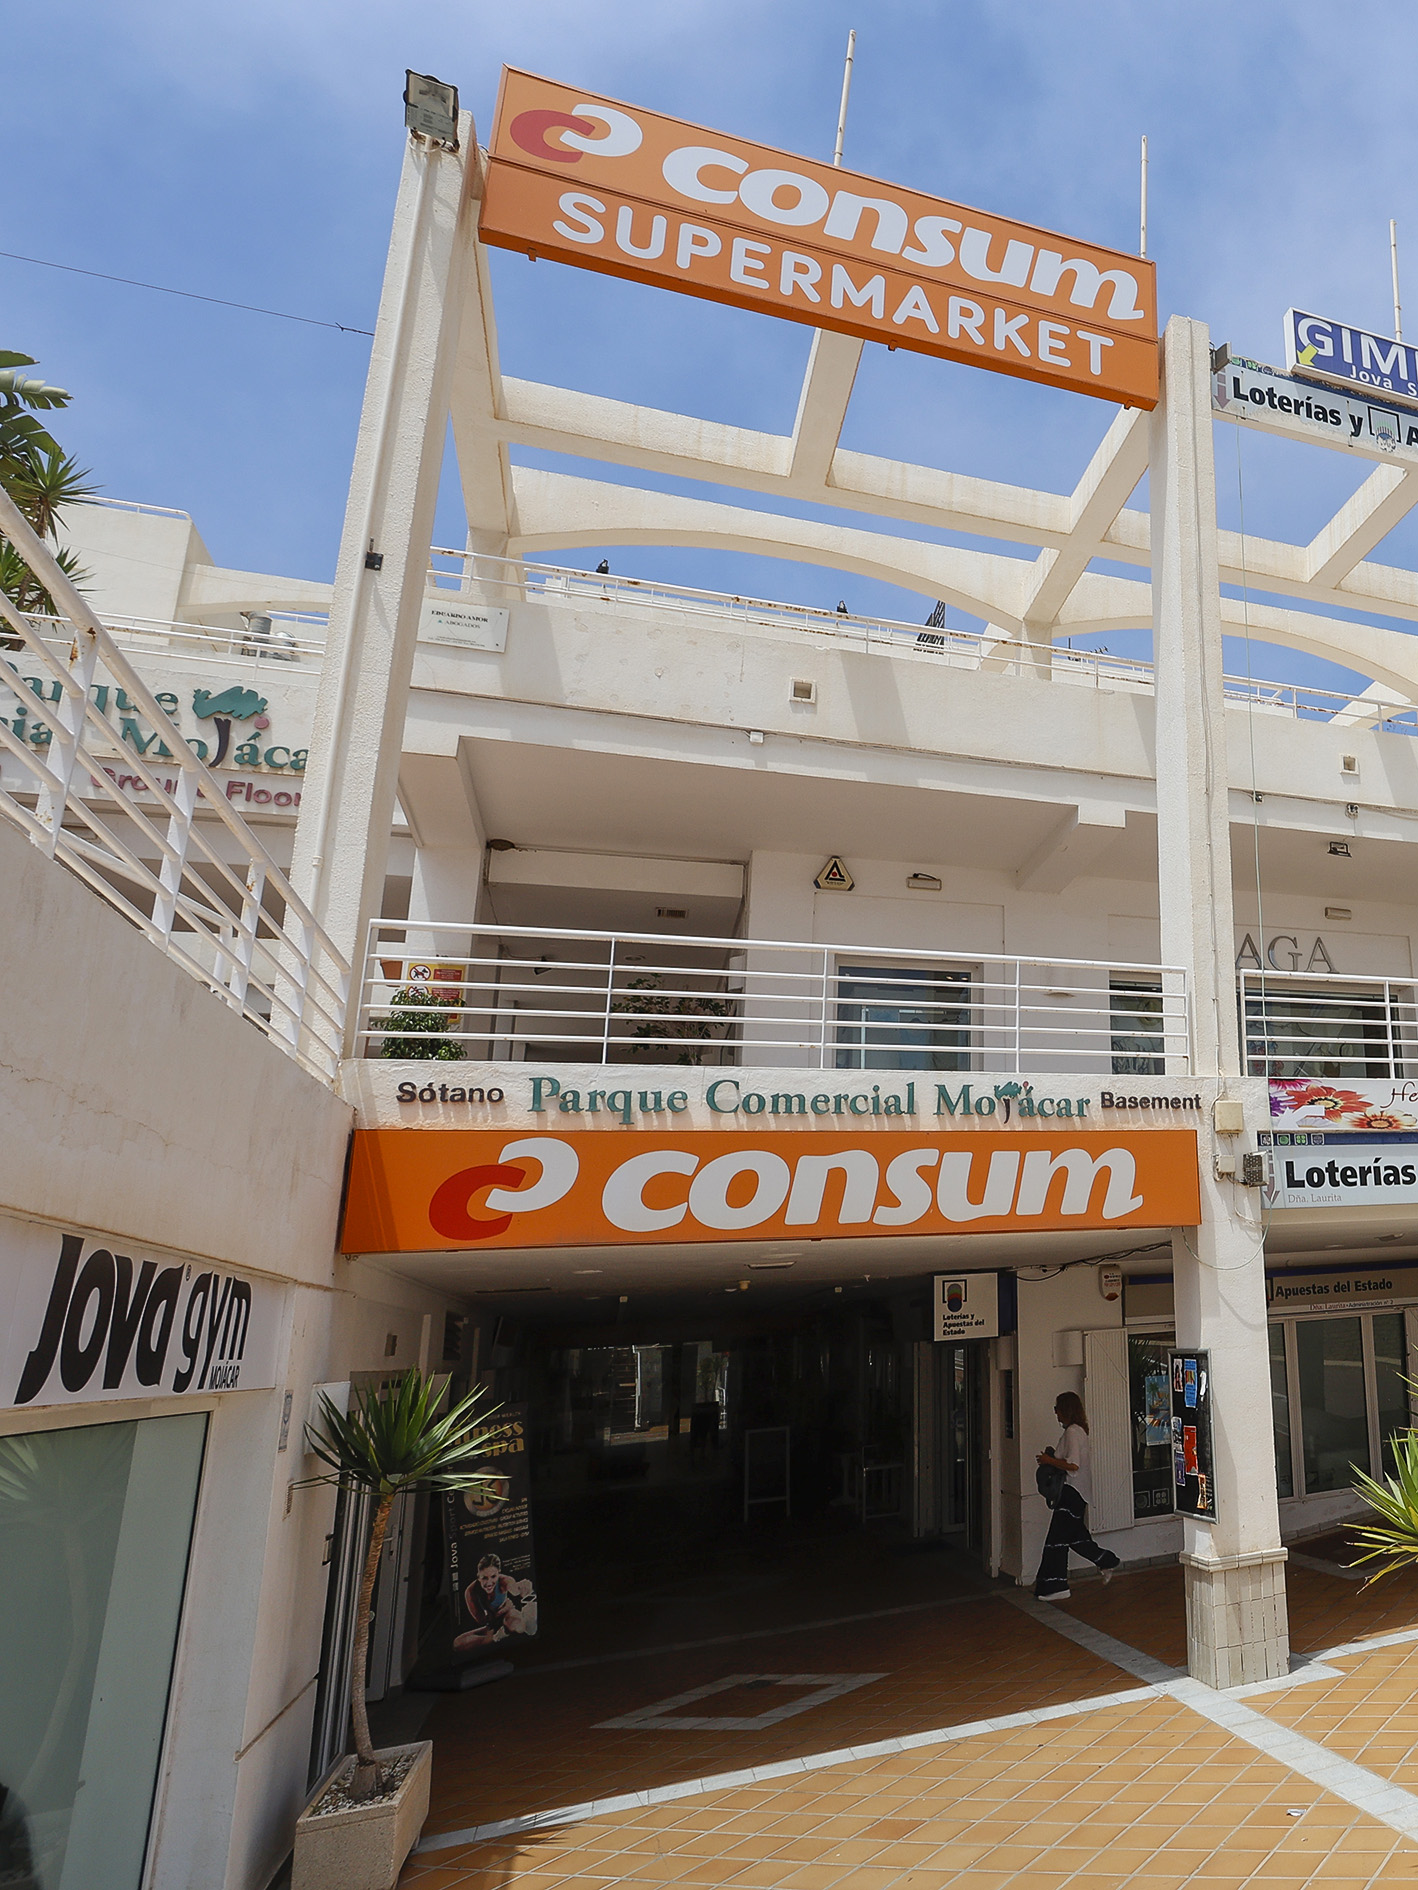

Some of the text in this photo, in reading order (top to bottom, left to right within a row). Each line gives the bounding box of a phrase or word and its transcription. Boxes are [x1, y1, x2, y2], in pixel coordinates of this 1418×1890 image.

[661, 145, 1144, 320] consum
[552, 191, 1114, 376] SUPERMARKET
[1350, 365, 1393, 390] Jova
[1232, 376, 1342, 426] Loterías
[1348, 413, 1363, 437] y
[396, 1081, 505, 1104] Sótano
[527, 1076, 689, 1125] Parque
[706, 1079, 917, 1116] Comercial
[1100, 1091, 1201, 1110] Basement
[1285, 1157, 1417, 1189] Loterías
[601, 1146, 1144, 1232] consum
[1311, 1193, 1342, 1203] Laurita
[1275, 1278, 1393, 1299] Apuestas del Estado
[942, 1313, 975, 1321] Loterías y
[943, 1321, 973, 1329] Apuestas
[172, 1270, 252, 1394] gym
[943, 1328, 966, 1336] Estado
[450, 1542, 459, 1568] Jova
